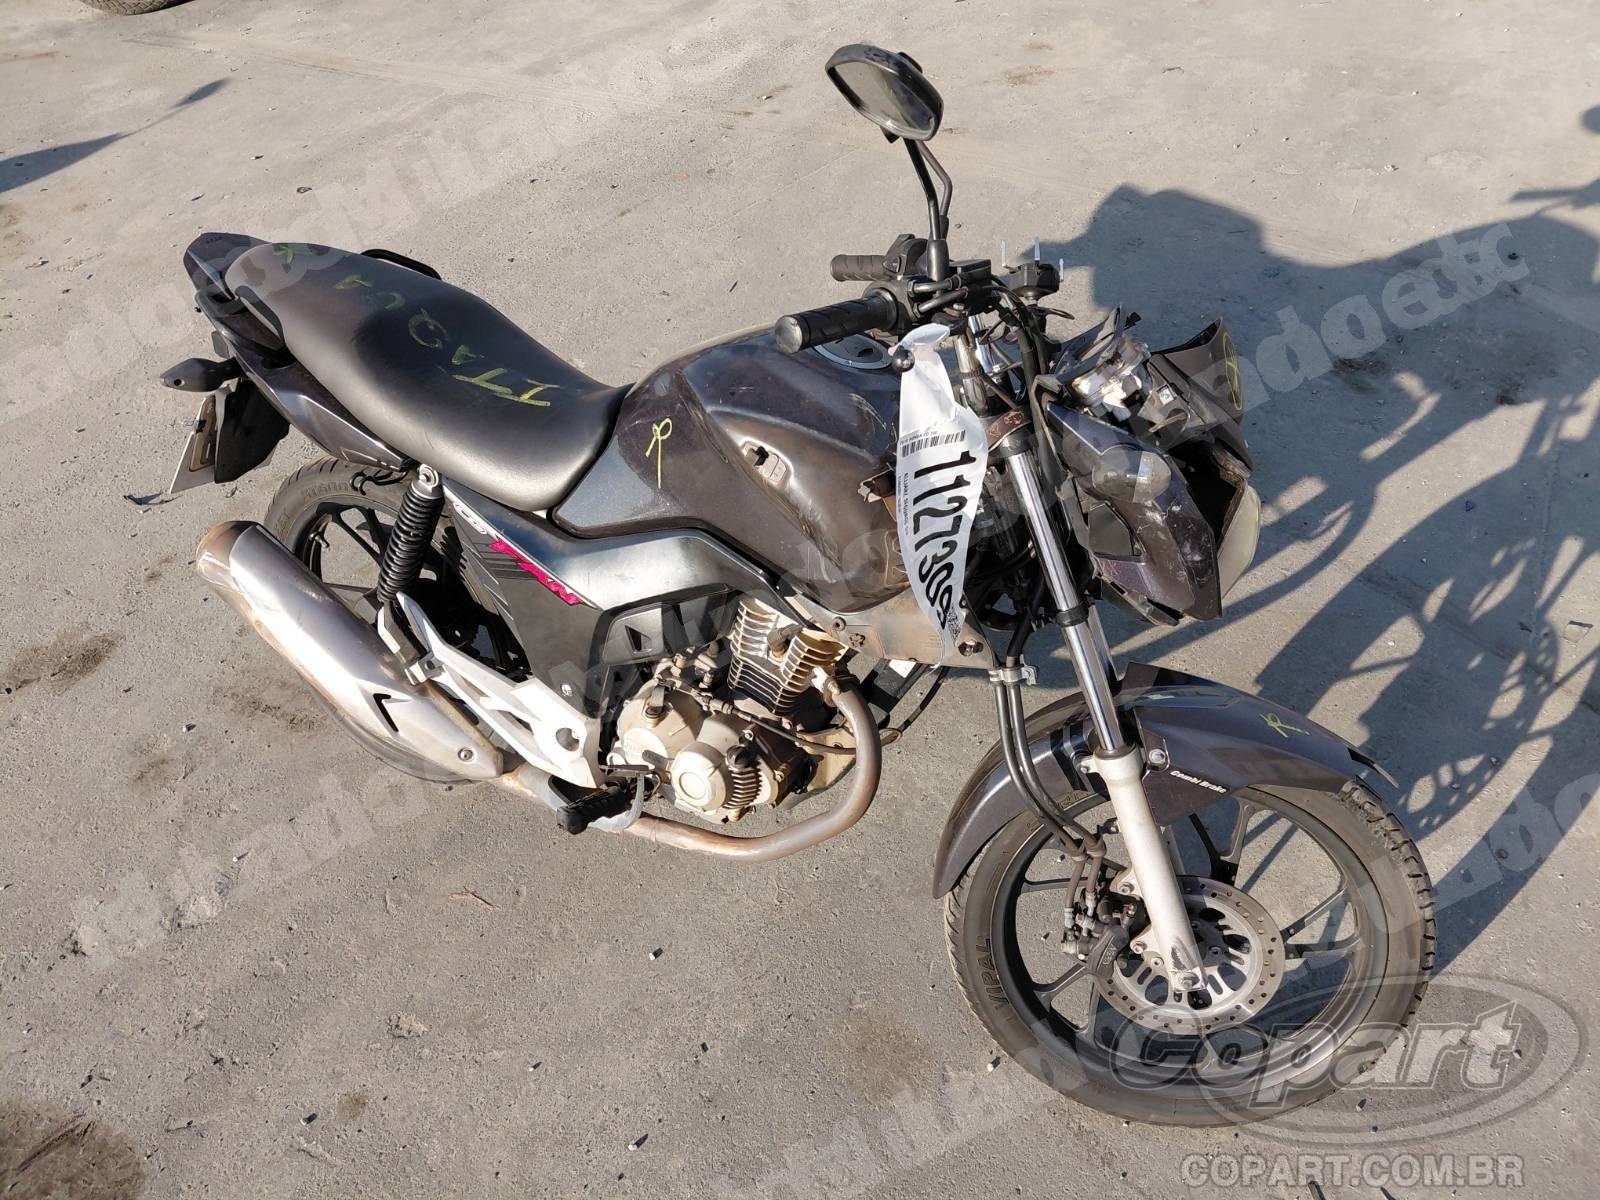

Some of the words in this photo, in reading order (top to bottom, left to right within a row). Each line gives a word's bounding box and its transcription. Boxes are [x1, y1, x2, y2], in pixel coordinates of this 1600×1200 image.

[913, 450, 977, 631] 1127309
[1169, 770, 1201, 785] Combi
[1199, 780, 1228, 794] Brake
